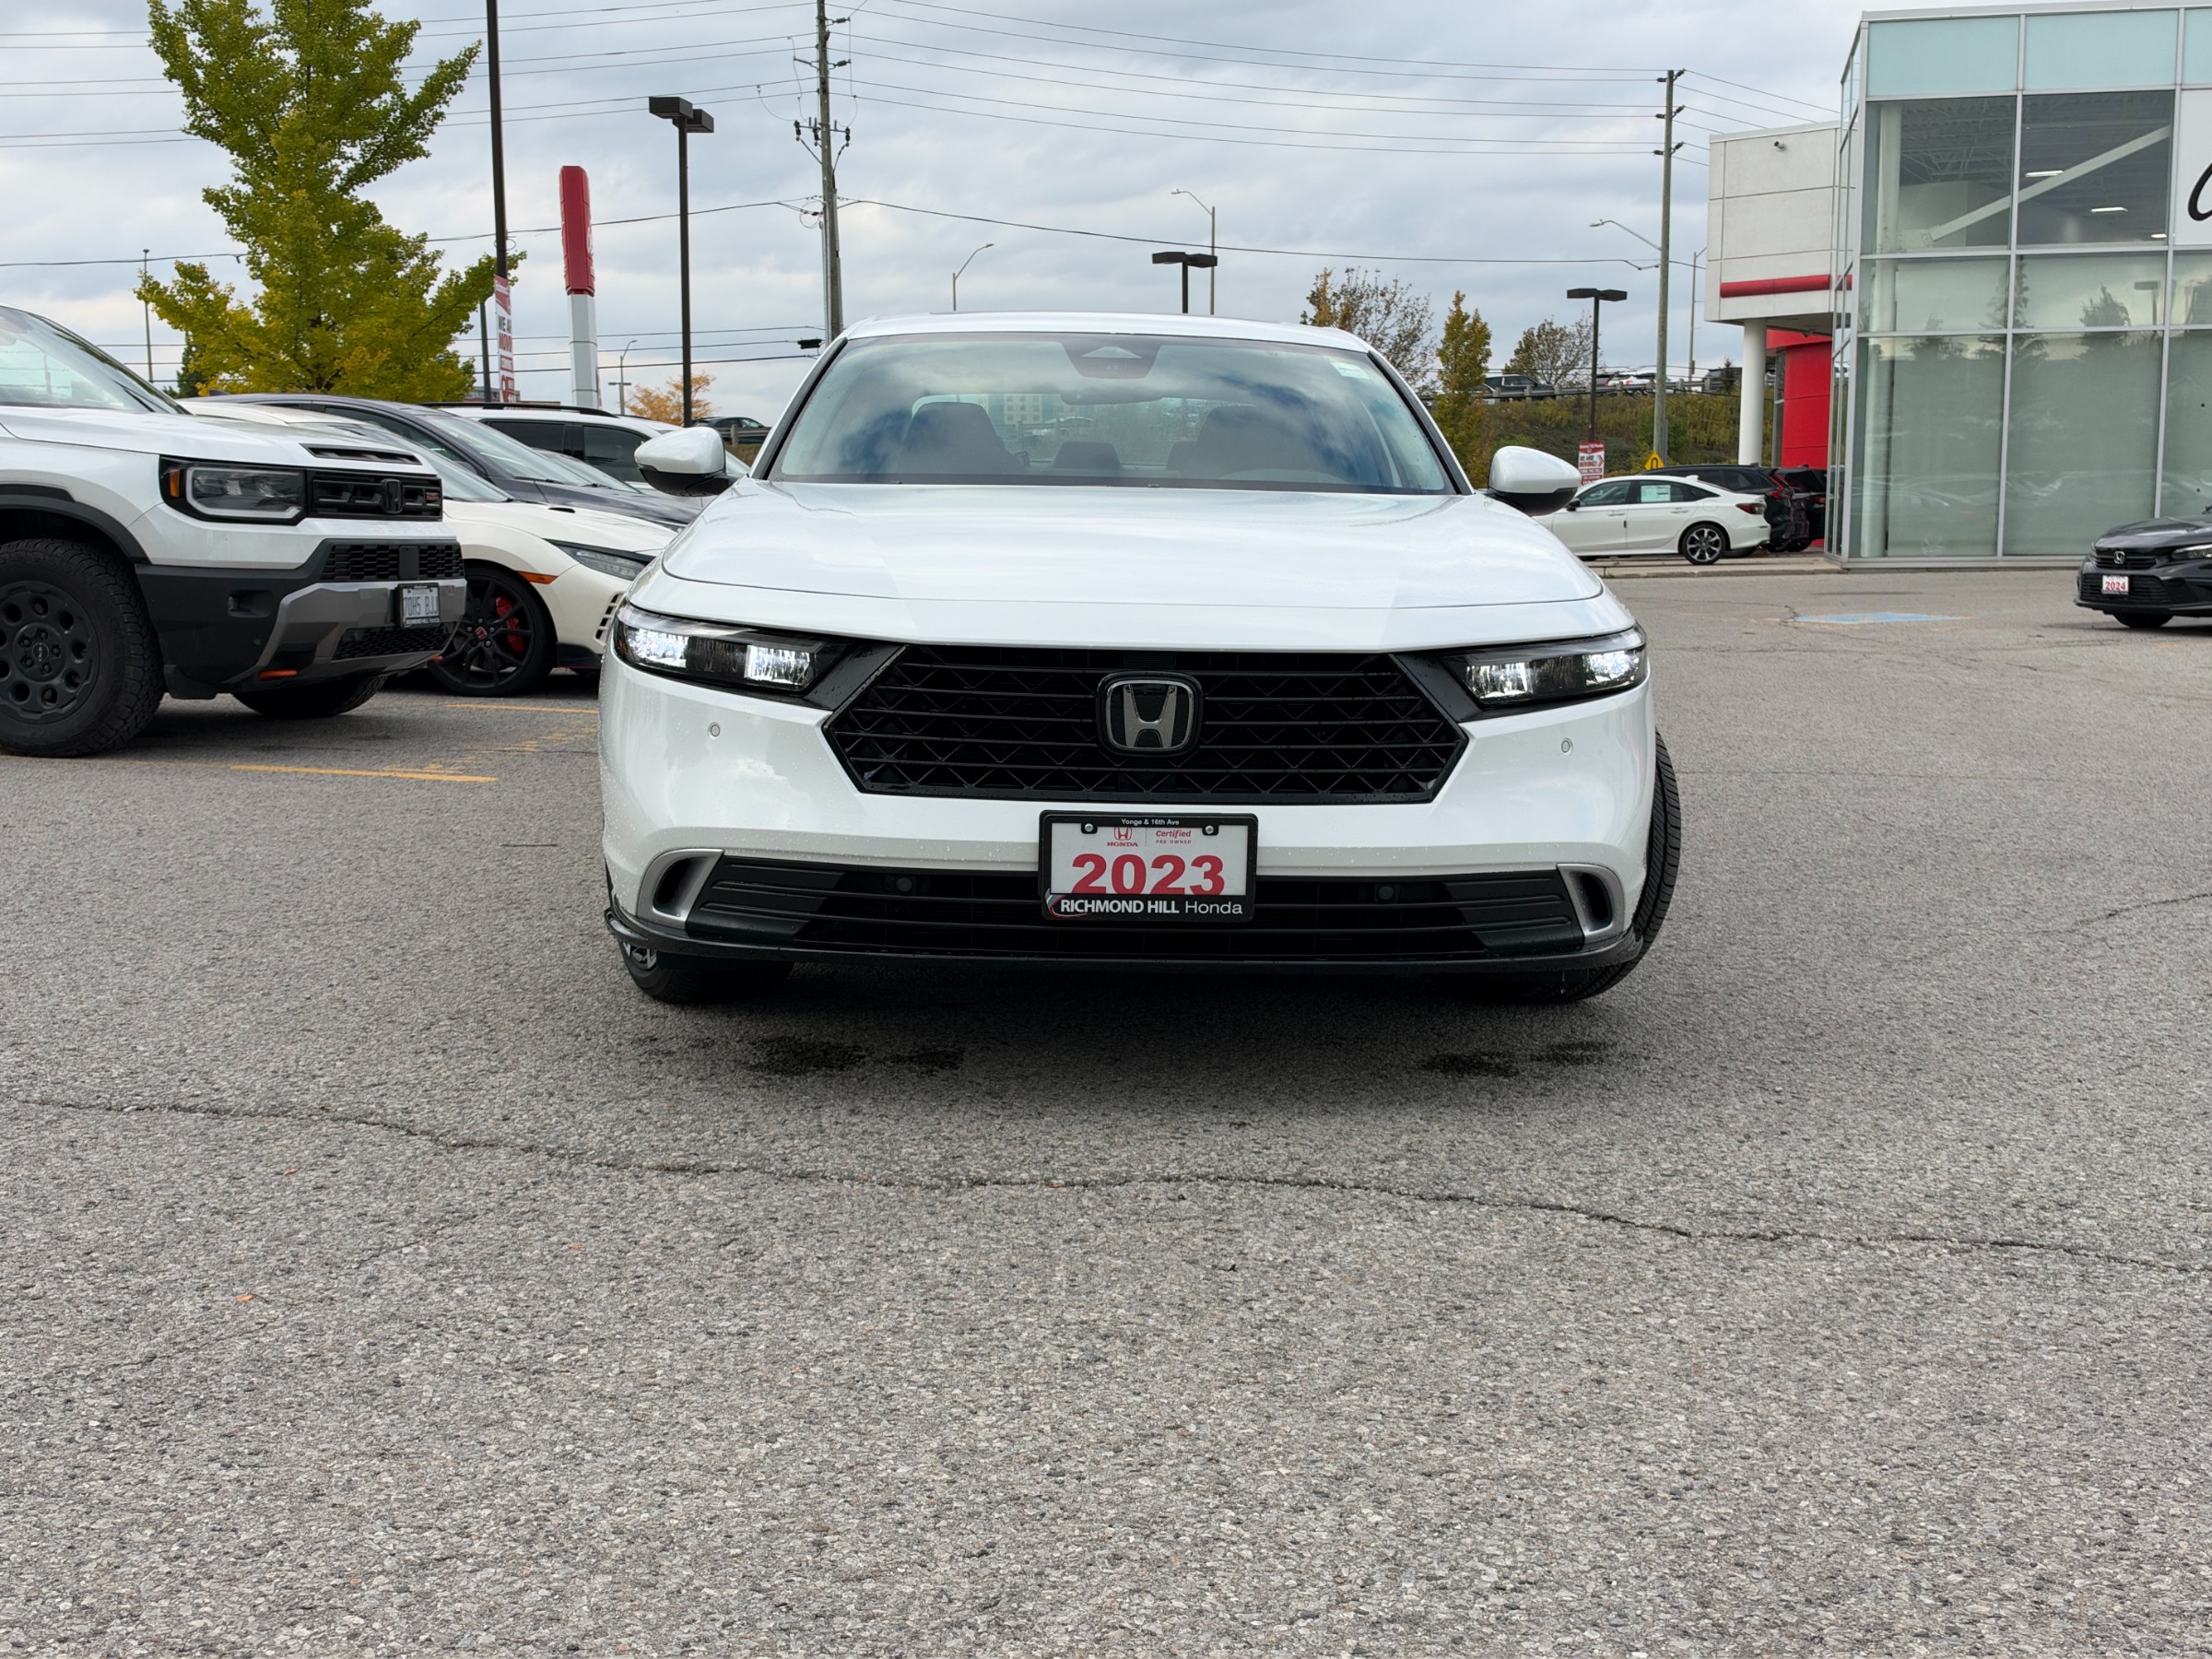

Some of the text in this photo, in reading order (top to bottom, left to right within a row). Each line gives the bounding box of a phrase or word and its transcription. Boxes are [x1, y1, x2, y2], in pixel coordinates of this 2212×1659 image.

[2105, 581, 2126, 591] 2024
[1121, 818, 1143, 827] Yonge
[1155, 830, 1192, 840] Certified
[1071, 853, 1225, 896] 2023
[1060, 899, 1243, 914] RICHMOND HILL Honda
